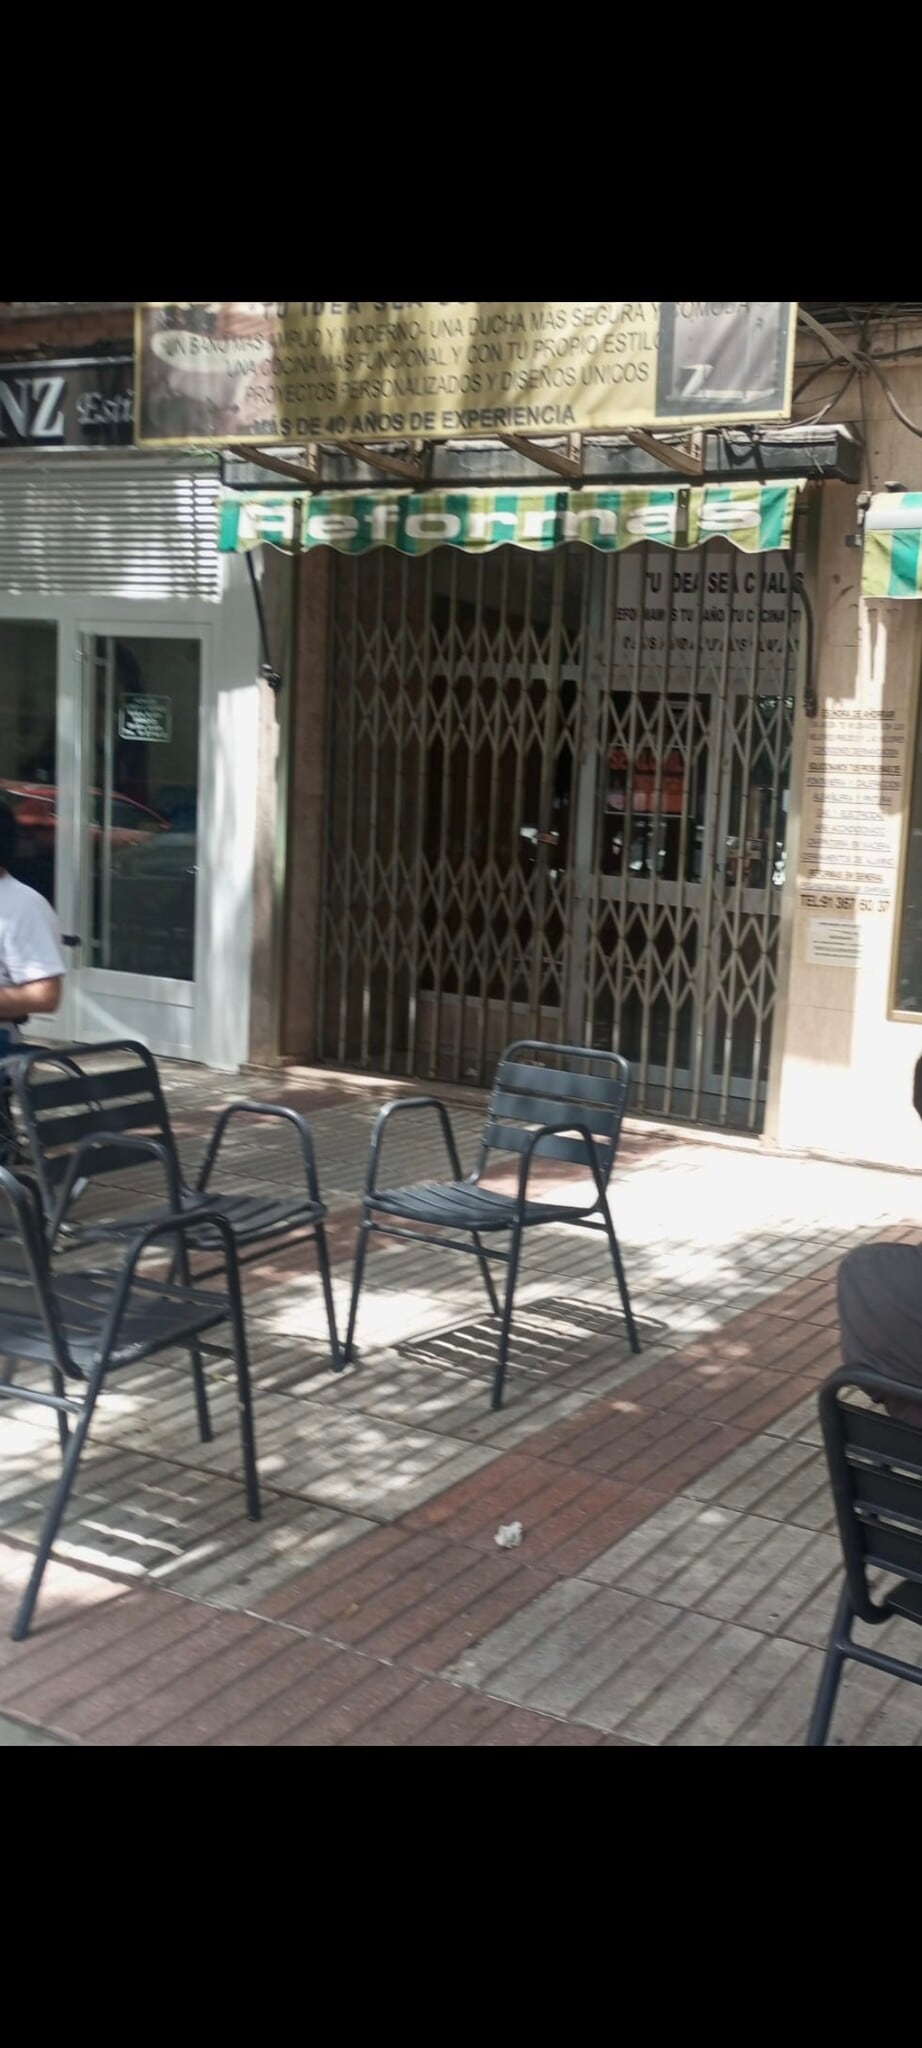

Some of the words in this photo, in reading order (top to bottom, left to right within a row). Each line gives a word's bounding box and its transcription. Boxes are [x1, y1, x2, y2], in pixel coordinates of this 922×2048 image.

[571, 302, 647, 328] SEGURA
[532, 332, 600, 360] PROPIO
[246, 381, 337, 404] PROYECTOS
[339, 372, 482, 402] PERSONALIZADOS
[297, 415, 322, 434] DE
[326, 414, 346, 434] 40
[352, 410, 405, 433] AÑOS
[410, 411, 436, 431] DE
[442, 403, 577, 428] EXPERIENCIA
[237, 499, 763, 541] Reformas
[670, 572, 700, 594] DEA
[700, 606, 726, 622] AÑO
